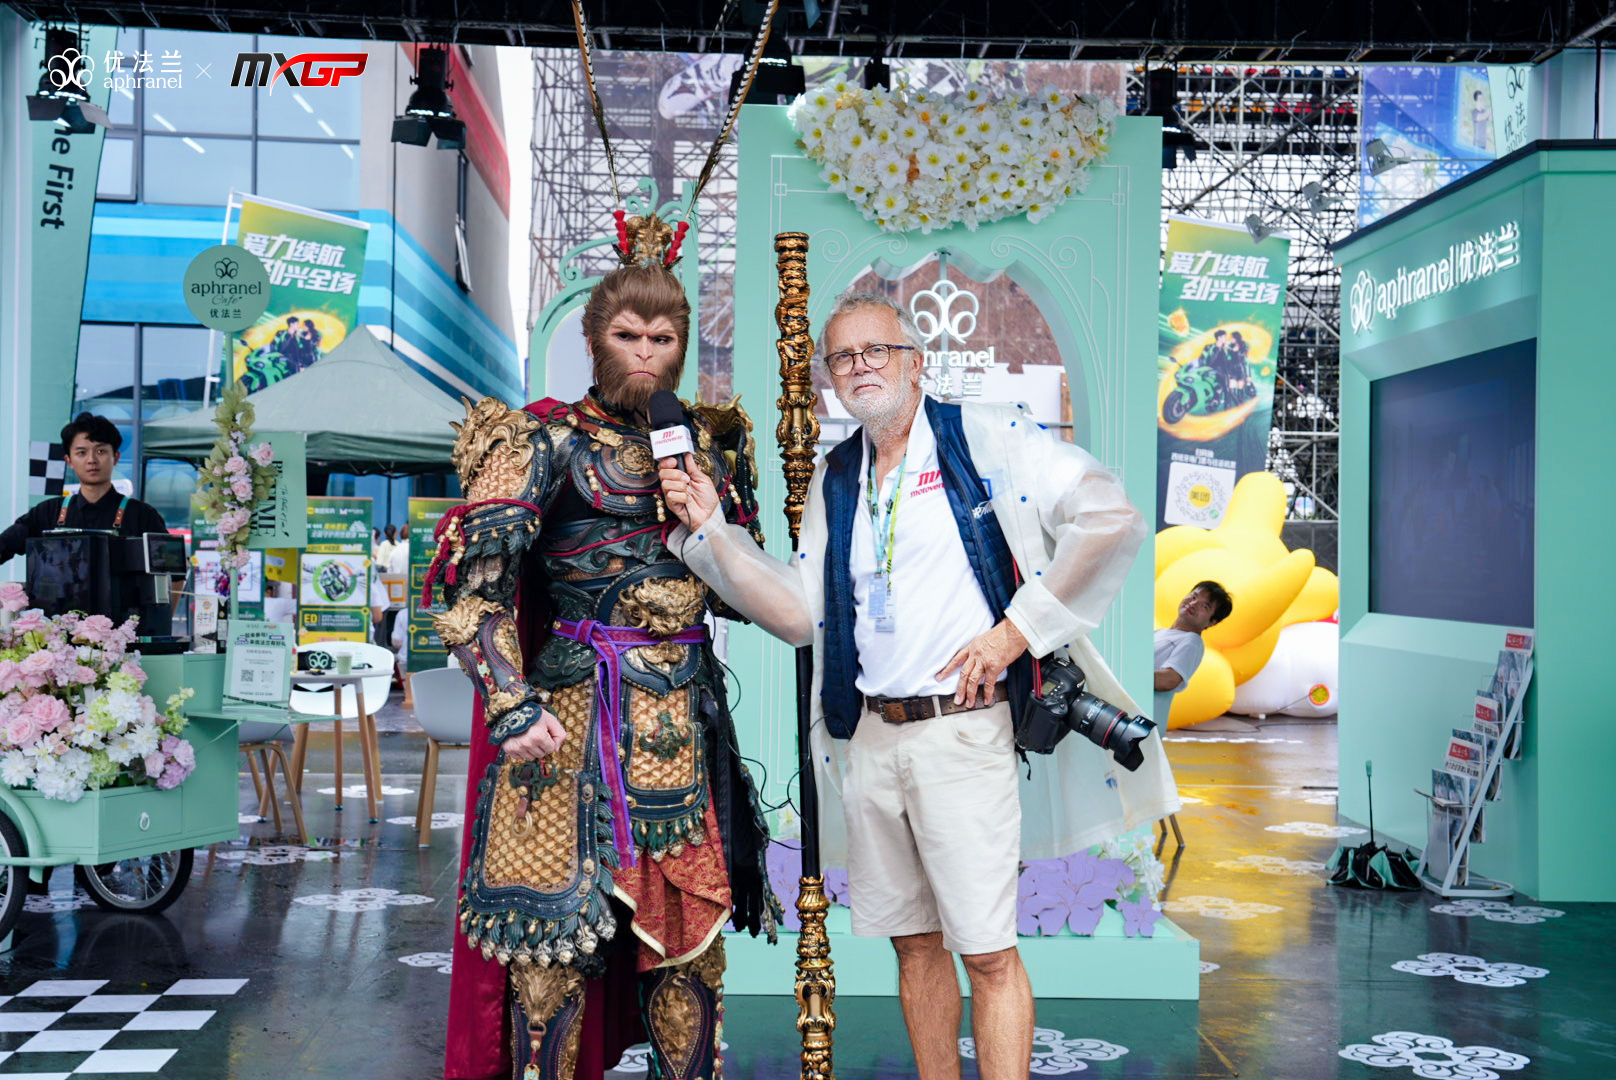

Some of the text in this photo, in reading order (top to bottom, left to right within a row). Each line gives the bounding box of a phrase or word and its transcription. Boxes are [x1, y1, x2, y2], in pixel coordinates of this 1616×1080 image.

[41, 164, 74, 230] First
[1167, 250, 1270, 280] 爱力续航
[1377, 220, 1520, 319] aphranel 优法兰
[191, 281, 262, 297] aphranel
[1179, 274, 1282, 305] 劲兴全场
[210, 308, 242, 319] 优法兰
[919, 373, 983, 397] 法兰
